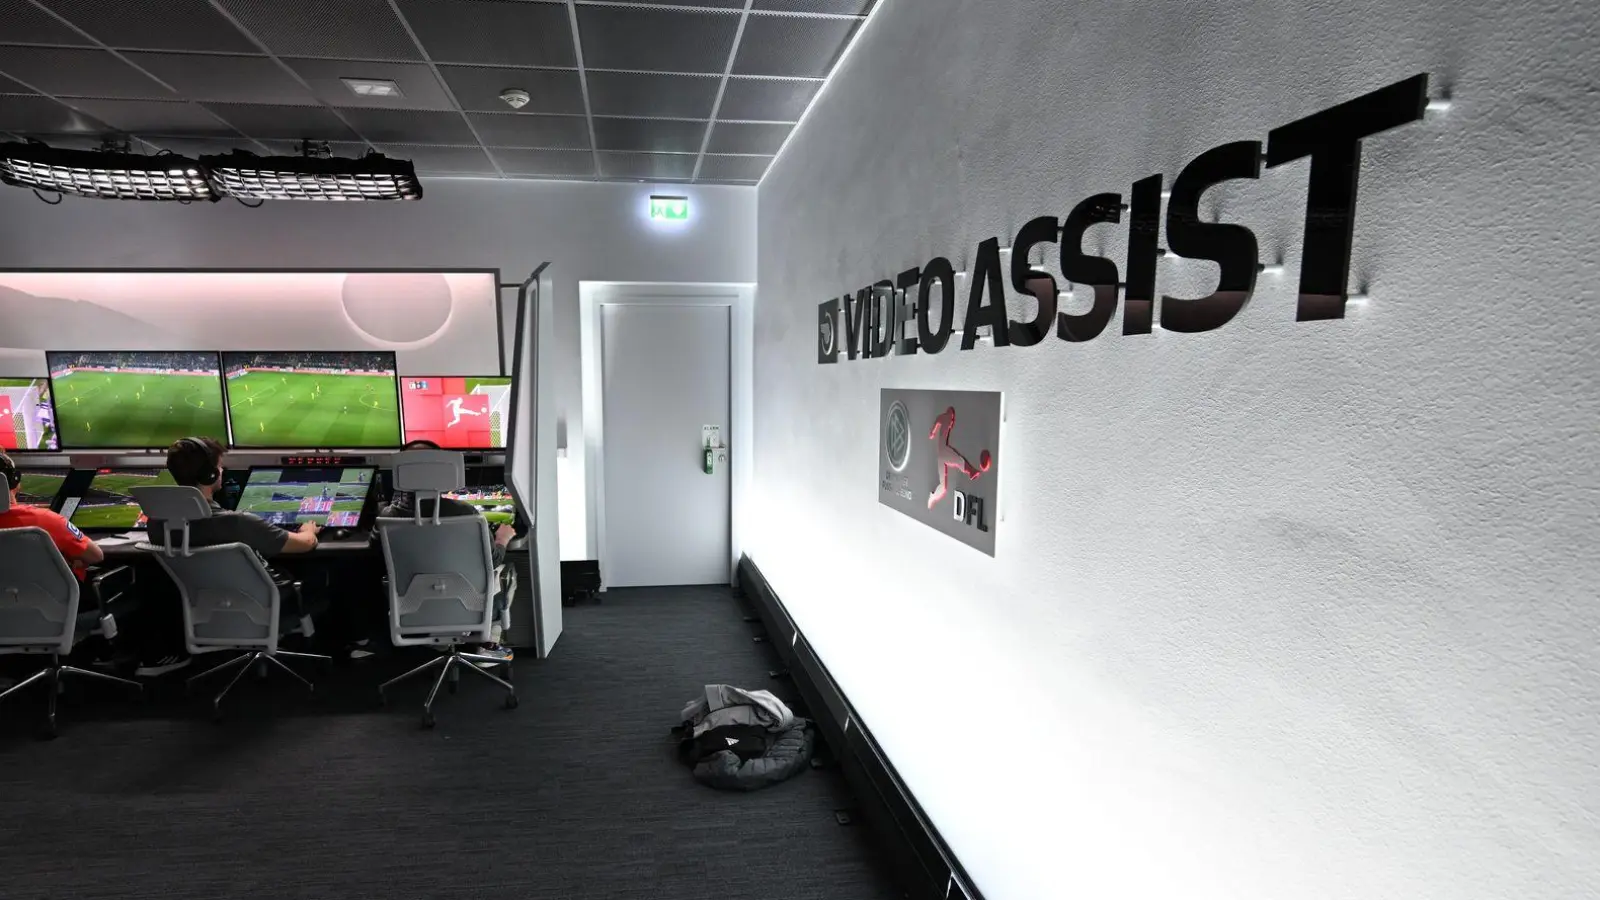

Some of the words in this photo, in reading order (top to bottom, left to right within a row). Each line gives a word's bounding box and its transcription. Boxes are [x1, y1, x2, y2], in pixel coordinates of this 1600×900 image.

[843, 256, 955, 360] VIDEO
[961, 73, 1428, 350] ASSIST
[953, 490, 988, 532] DFL
